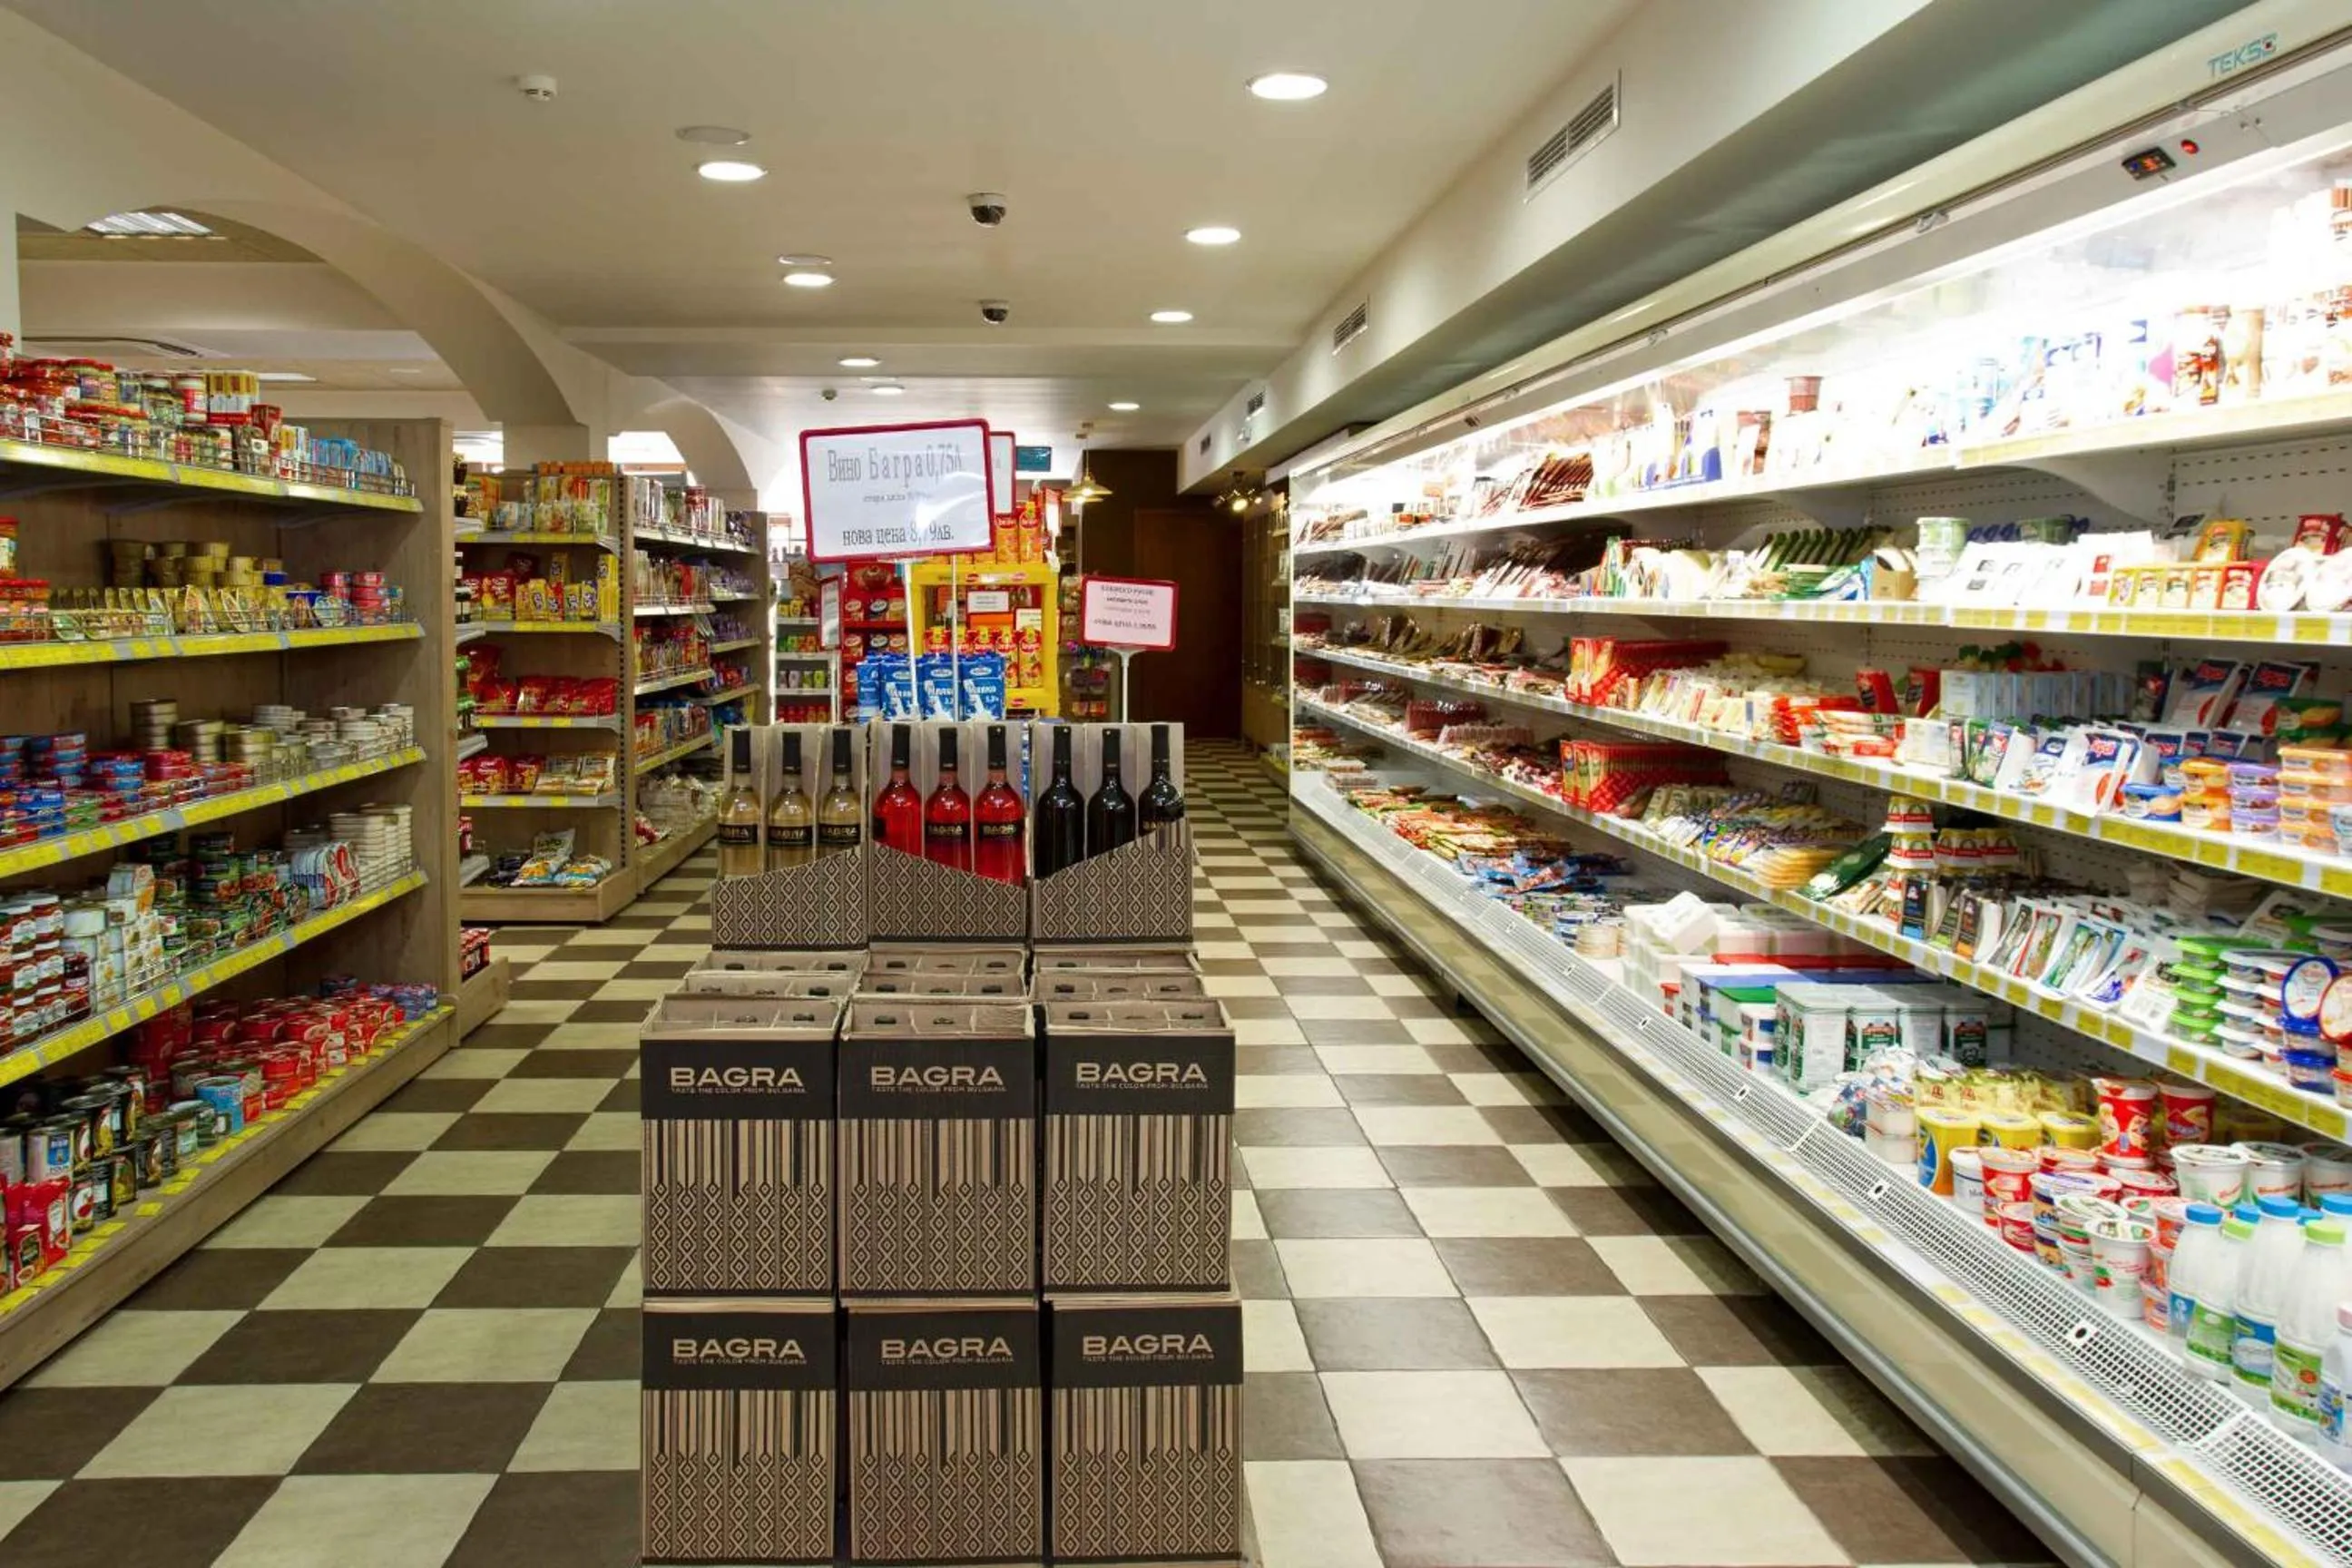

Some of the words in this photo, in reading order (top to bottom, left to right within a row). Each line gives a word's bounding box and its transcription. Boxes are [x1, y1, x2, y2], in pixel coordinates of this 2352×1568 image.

[828, 450, 862, 482] Вино
[868, 448, 924, 487] Багра
[842, 530, 873, 545] нова
[876, 526, 908, 546] цена
[670, 1067, 803, 1087] BAGRA
[871, 1066, 1004, 1086] BAGRA
[1076, 1063, 1207, 1083] BAGRA
[672, 1338, 805, 1358] BAGRA
[881, 1337, 1013, 1358] BAGRA
[1083, 1334, 1213, 1356] BAGRA
